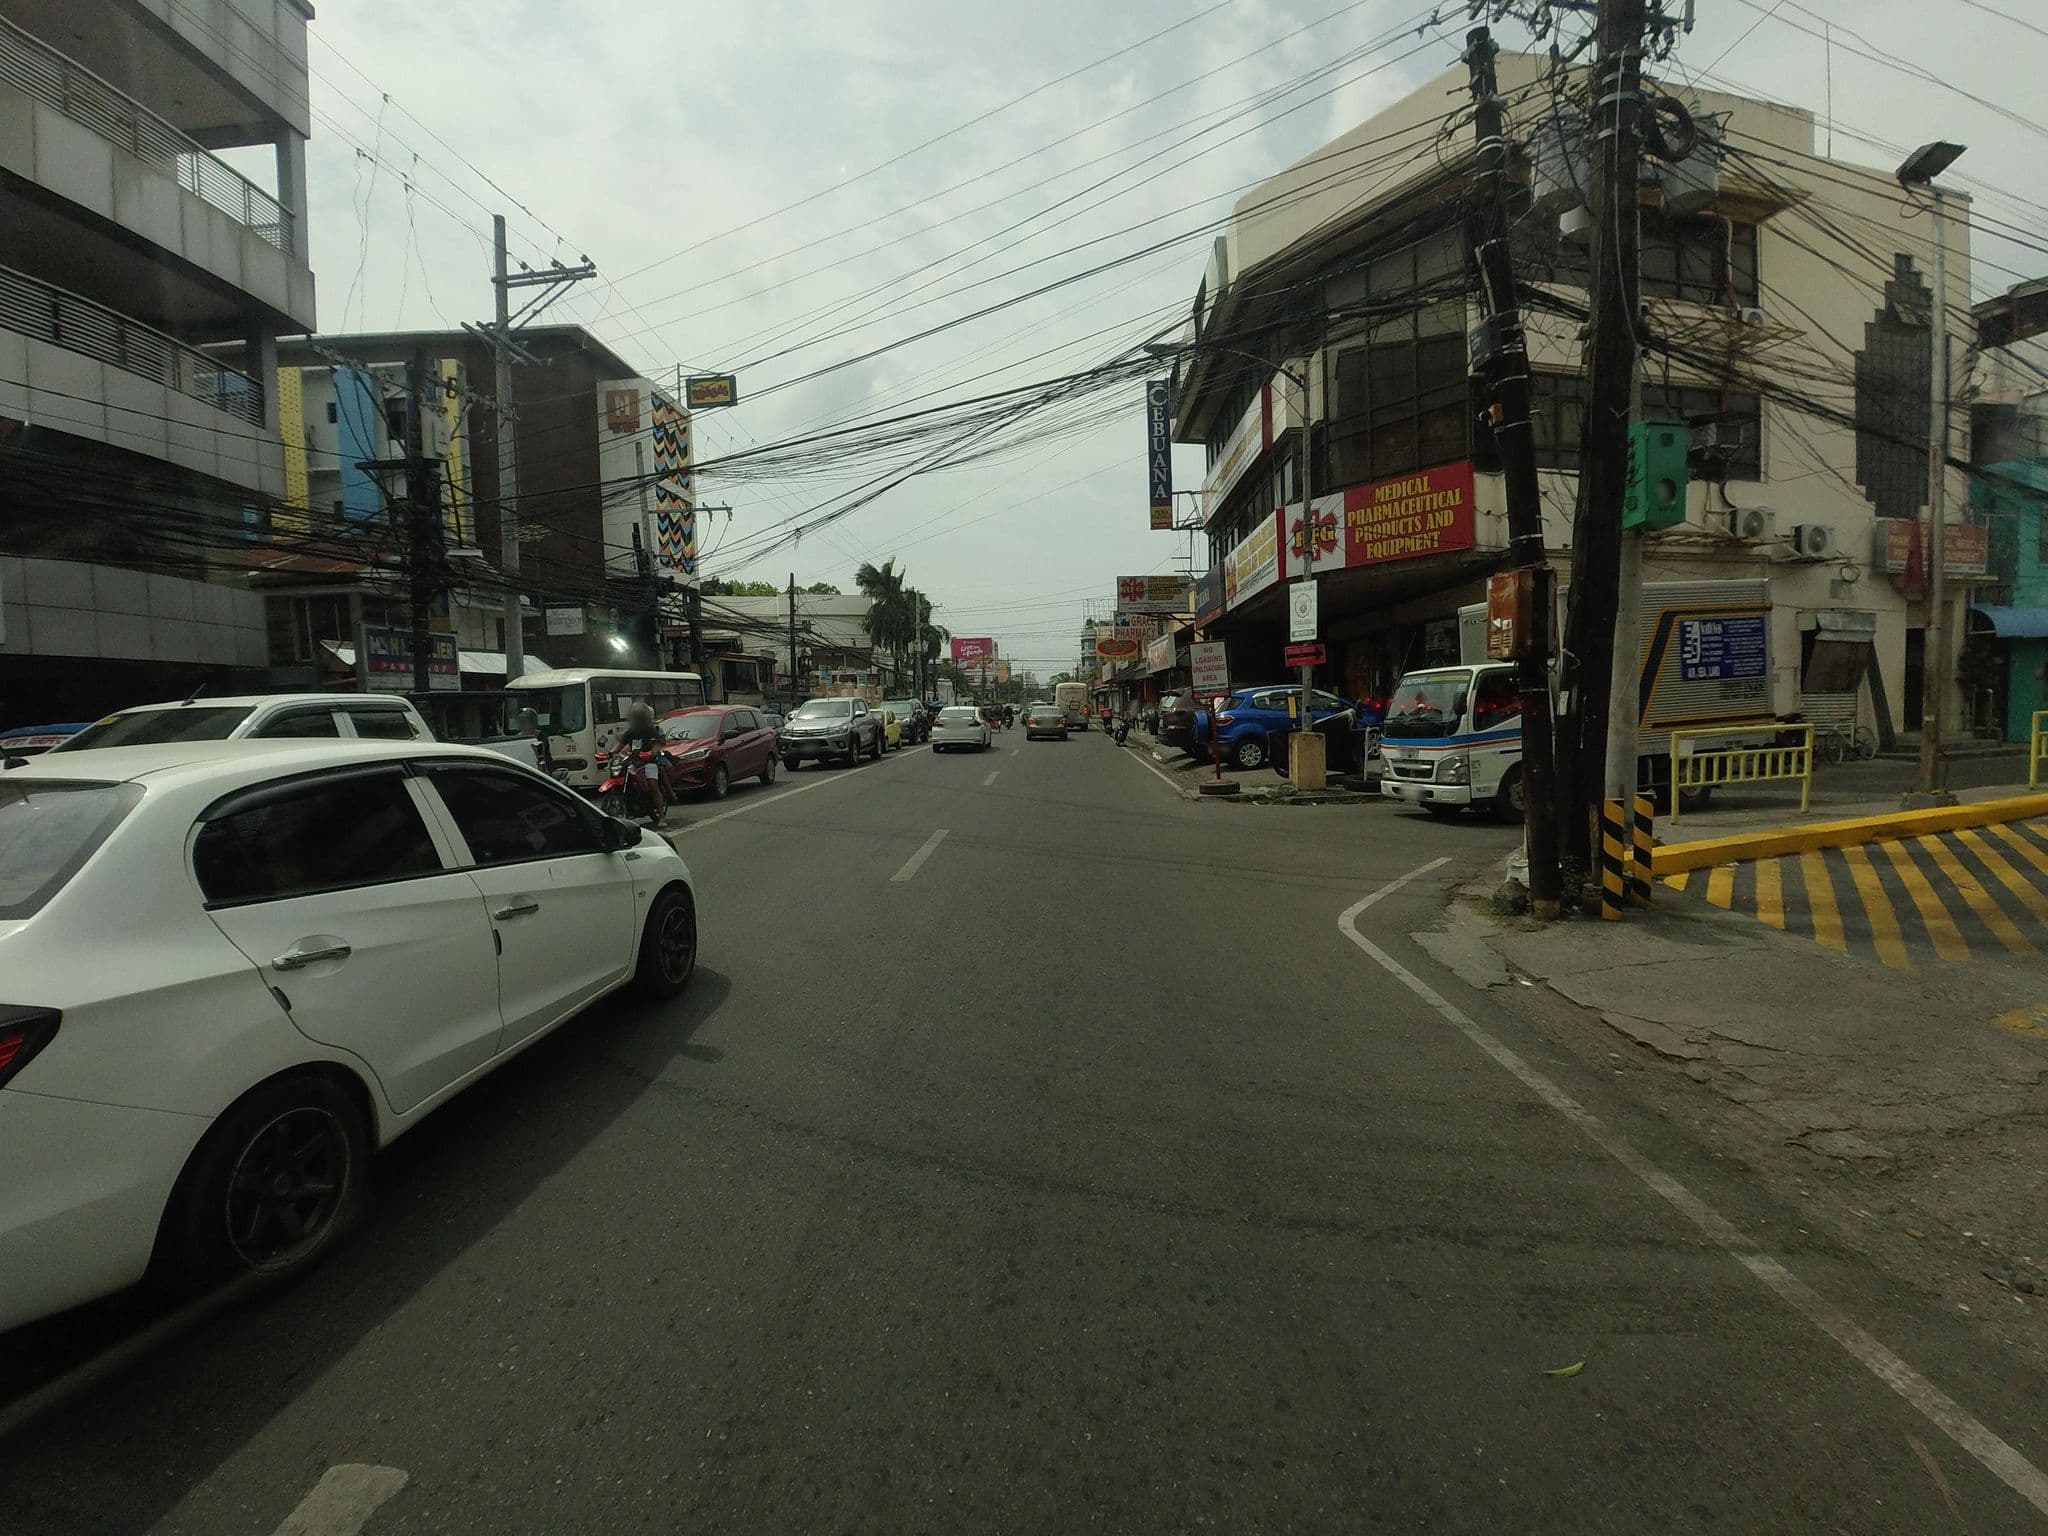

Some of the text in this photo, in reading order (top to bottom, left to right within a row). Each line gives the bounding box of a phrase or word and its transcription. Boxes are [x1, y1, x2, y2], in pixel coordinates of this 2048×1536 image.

[1150, 384, 1168, 499] CEBUANA
[1375, 476, 1430, 503] MEDICAL
[1347, 488, 1463, 527] PHARMACEUTICAL
[1354, 510, 1454, 543] PRODUCTS AND
[1366, 531, 1441, 560] EQUIPMENT
[1115, 627, 1156, 639] PHARMACY
[1195, 655, 1224, 664] LOADING
